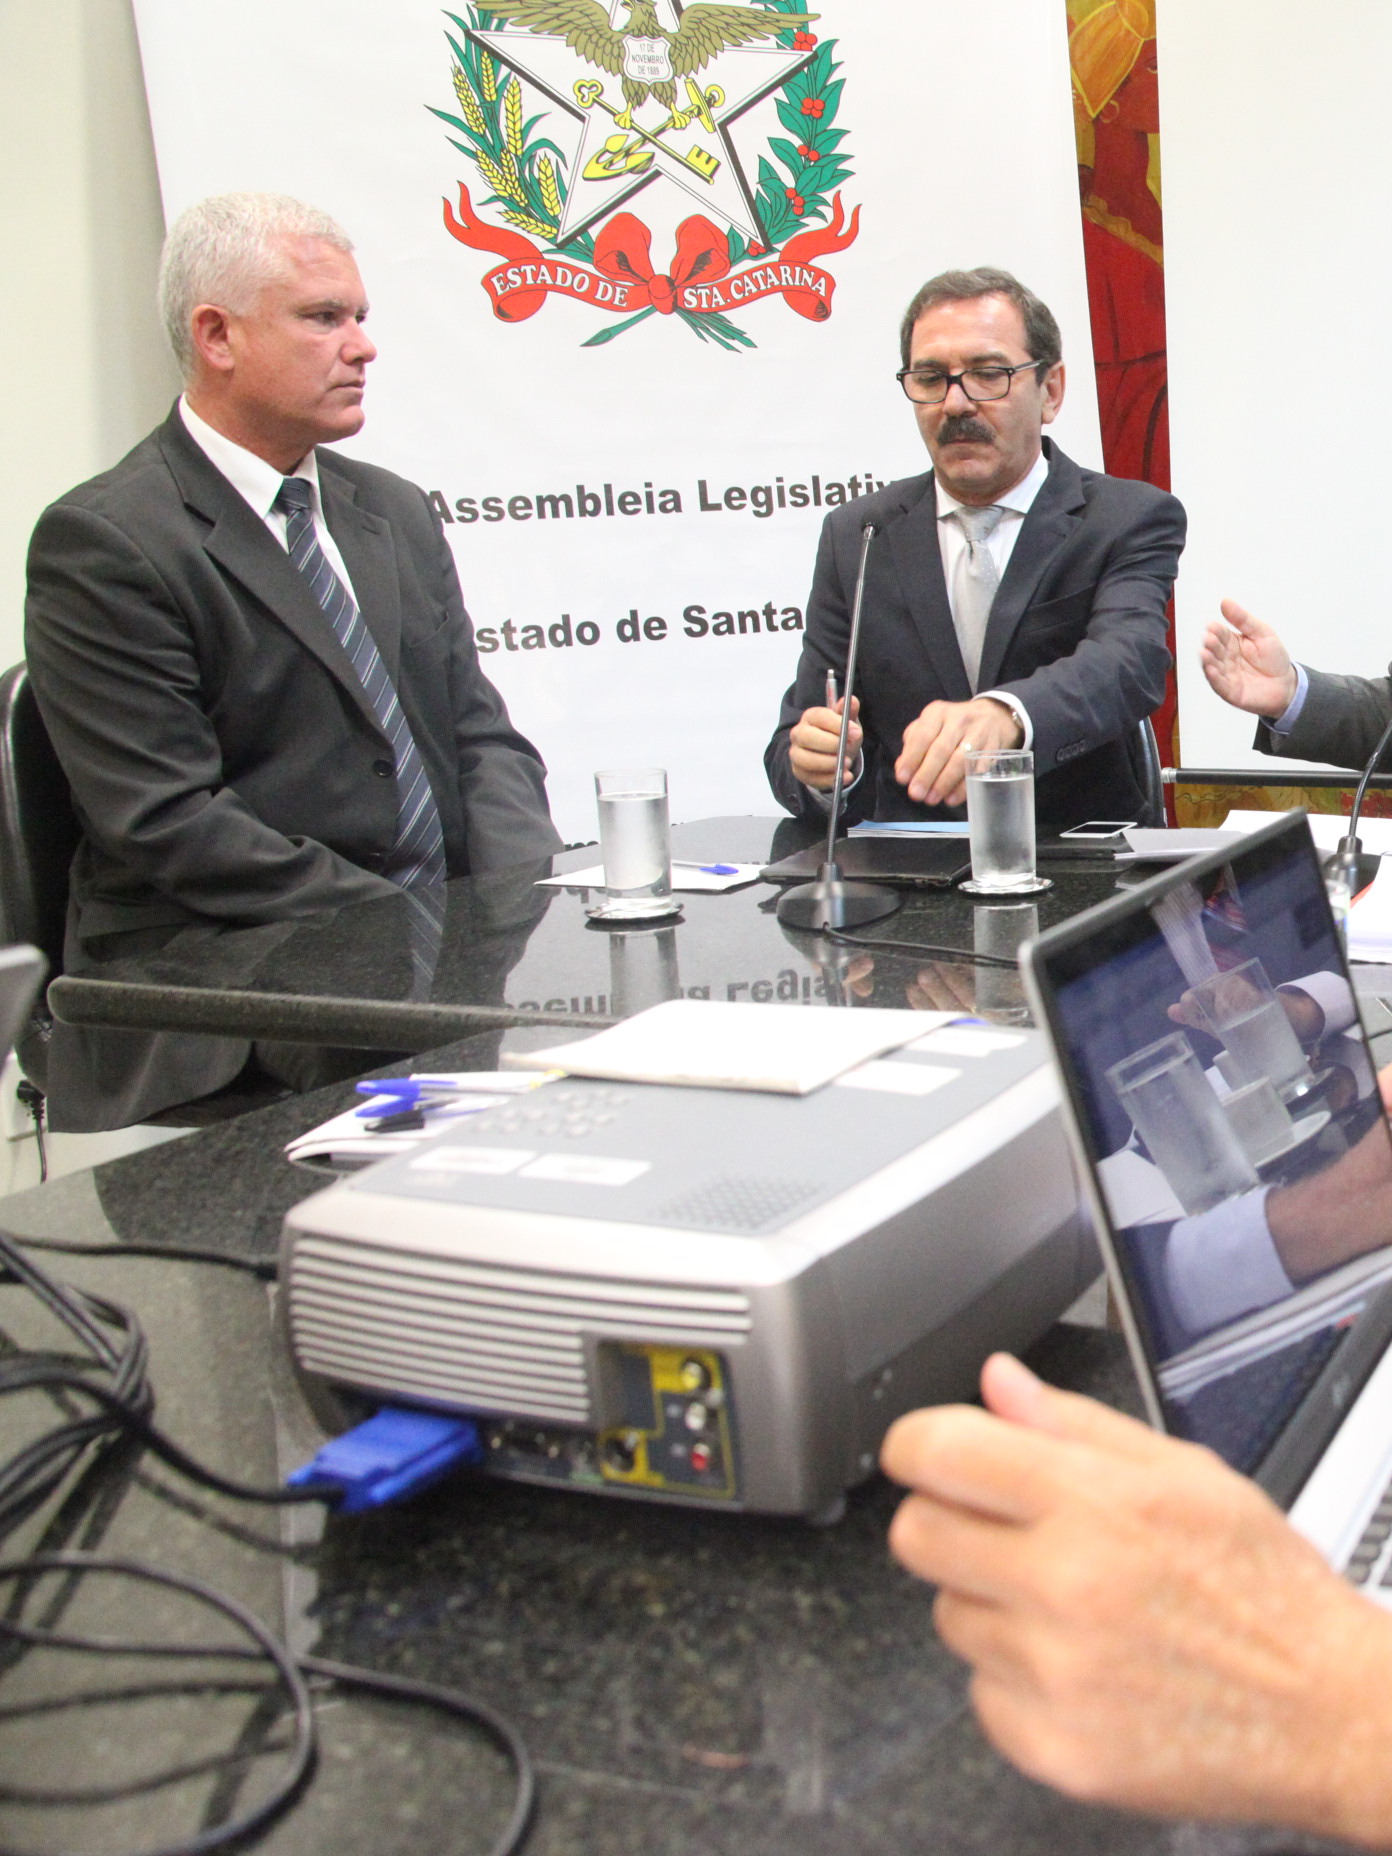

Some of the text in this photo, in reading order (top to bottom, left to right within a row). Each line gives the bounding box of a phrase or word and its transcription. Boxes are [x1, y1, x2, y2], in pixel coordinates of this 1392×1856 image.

[631, 54, 665, 65] NOVEMBRO
[639, 43, 655, 53] 17 DE
[637, 65, 646, 75] DE
[490, 264, 629, 307] ESTADO DE
[730, 265, 827, 297] CATARINA
[429, 481, 683, 524] Assembleia
[475, 600, 805, 653] stado de Santa
